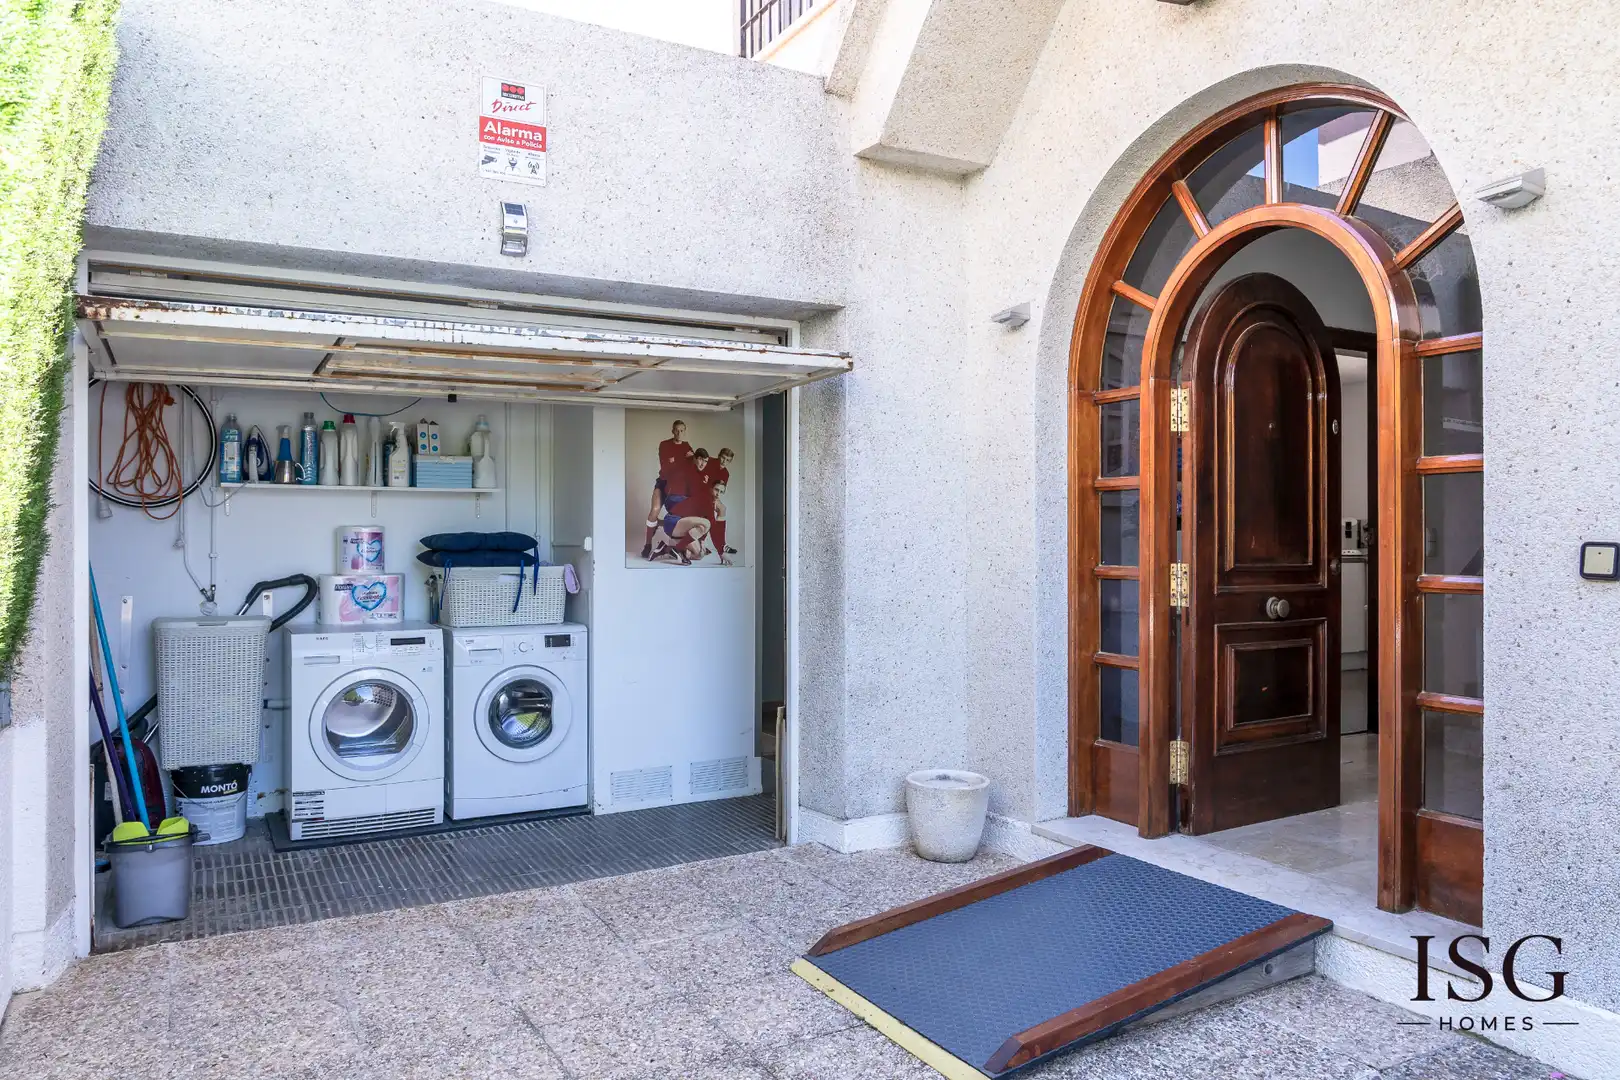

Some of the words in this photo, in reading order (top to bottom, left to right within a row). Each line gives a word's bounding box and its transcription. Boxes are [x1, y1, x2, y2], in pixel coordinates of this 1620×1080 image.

[491, 98, 537, 113] Direct
[483, 121, 543, 141] Alarma
[496, 136, 515, 144] Aviso
[200, 779, 238, 794] MONTÓ
